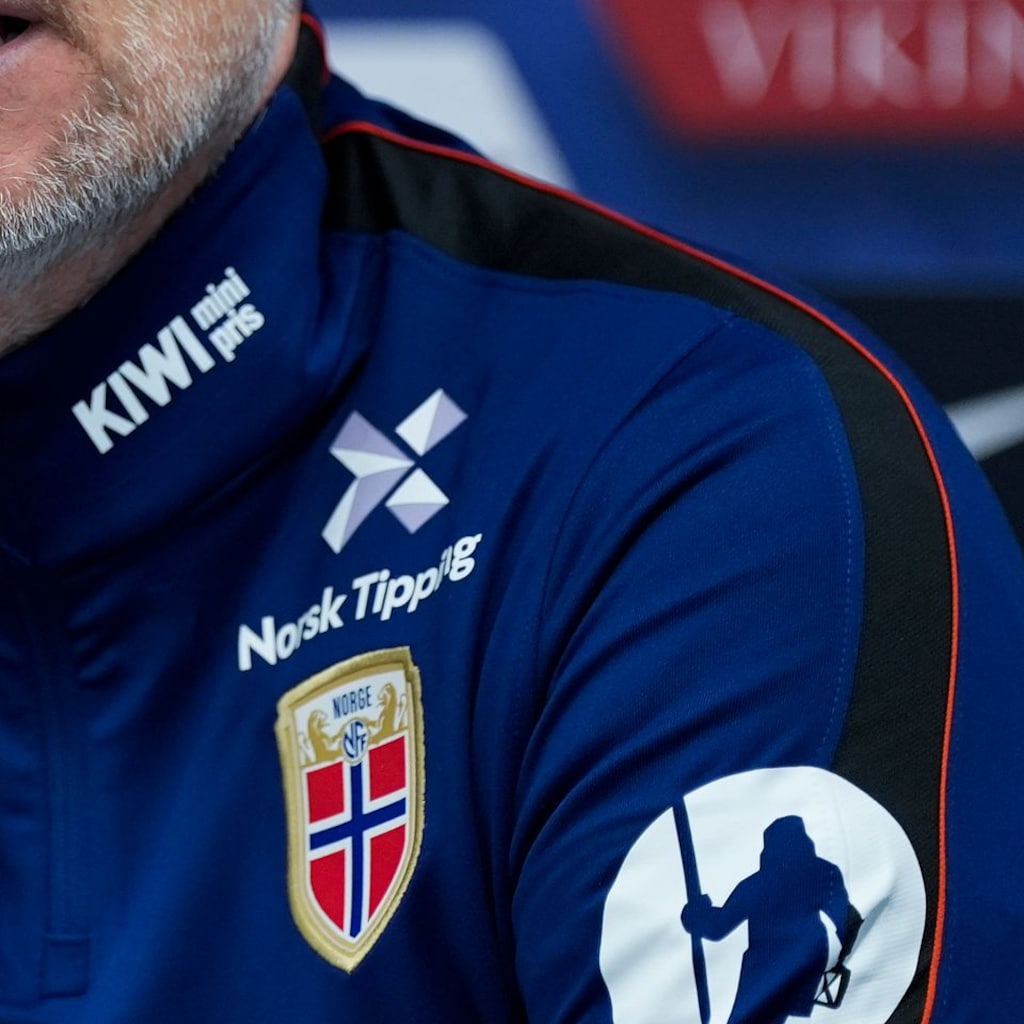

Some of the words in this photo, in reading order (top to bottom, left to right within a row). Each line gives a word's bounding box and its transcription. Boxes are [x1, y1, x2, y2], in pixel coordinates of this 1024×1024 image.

[190, 266, 251, 331] mini
[71, 314, 216, 455] KIWI
[208, 303, 265, 363] pris
[238, 586, 348, 671] Norsk
[332, 685, 372, 718] NORGE
